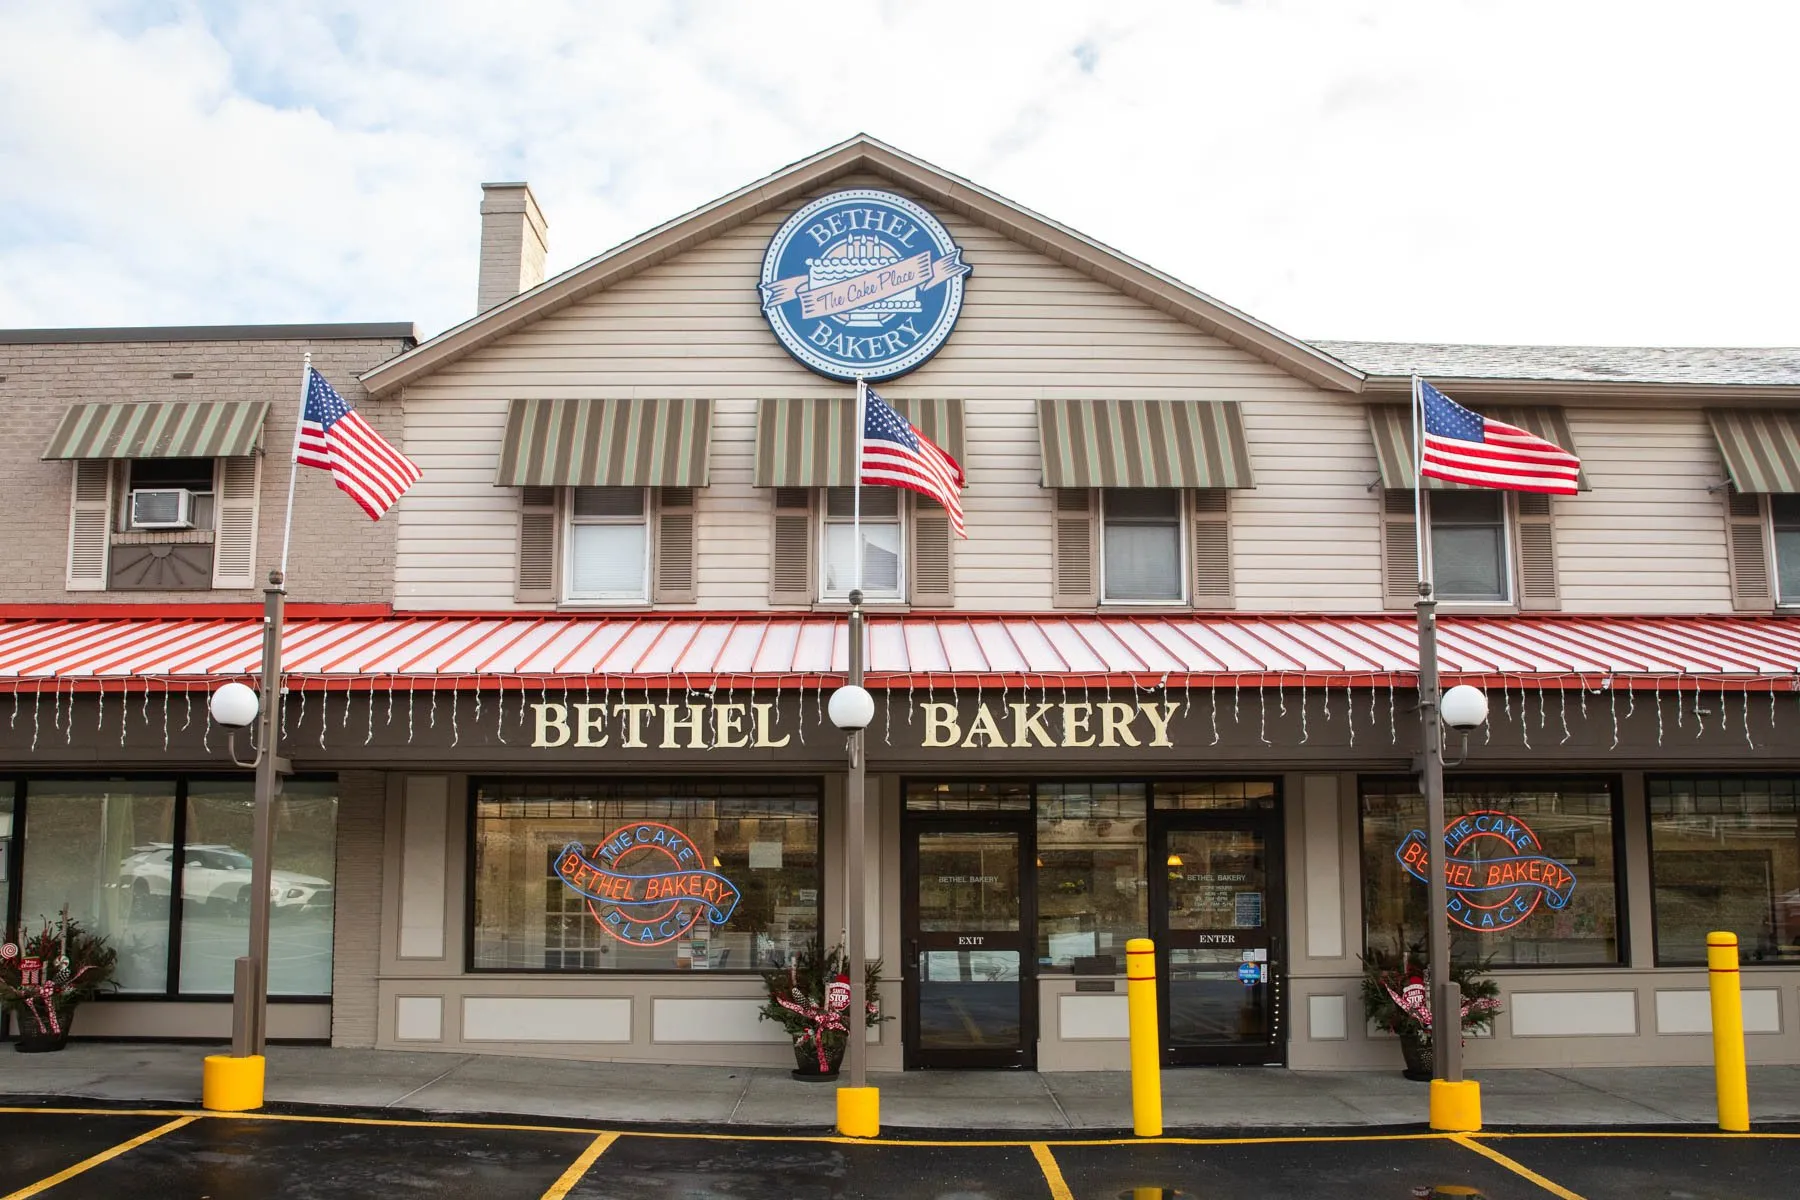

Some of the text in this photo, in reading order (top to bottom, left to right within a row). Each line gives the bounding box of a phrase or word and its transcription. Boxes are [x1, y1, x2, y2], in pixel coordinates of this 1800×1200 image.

[806, 208, 919, 248] BETHEL
[817, 269, 915, 311] The Cake Place
[808, 316, 923, 359] BAKERY
[530, 702, 1180, 749] BETHEL BAKERY
[600, 826, 694, 862] THE CAKE
[1444, 816, 1532, 849] THE CAKE
[561, 853, 734, 904] BETHEL BAKERY
[1403, 842, 1572, 889] BEHEL BAKERY
[605, 910, 690, 941] PLACE
[1446, 895, 1529, 927] PLACE
[958, 936, 984, 945] EXIT
[1200, 934, 1235, 943] ENTER
[829, 994, 849, 1002] STOP
[1406, 994, 1424, 1004] STOP
